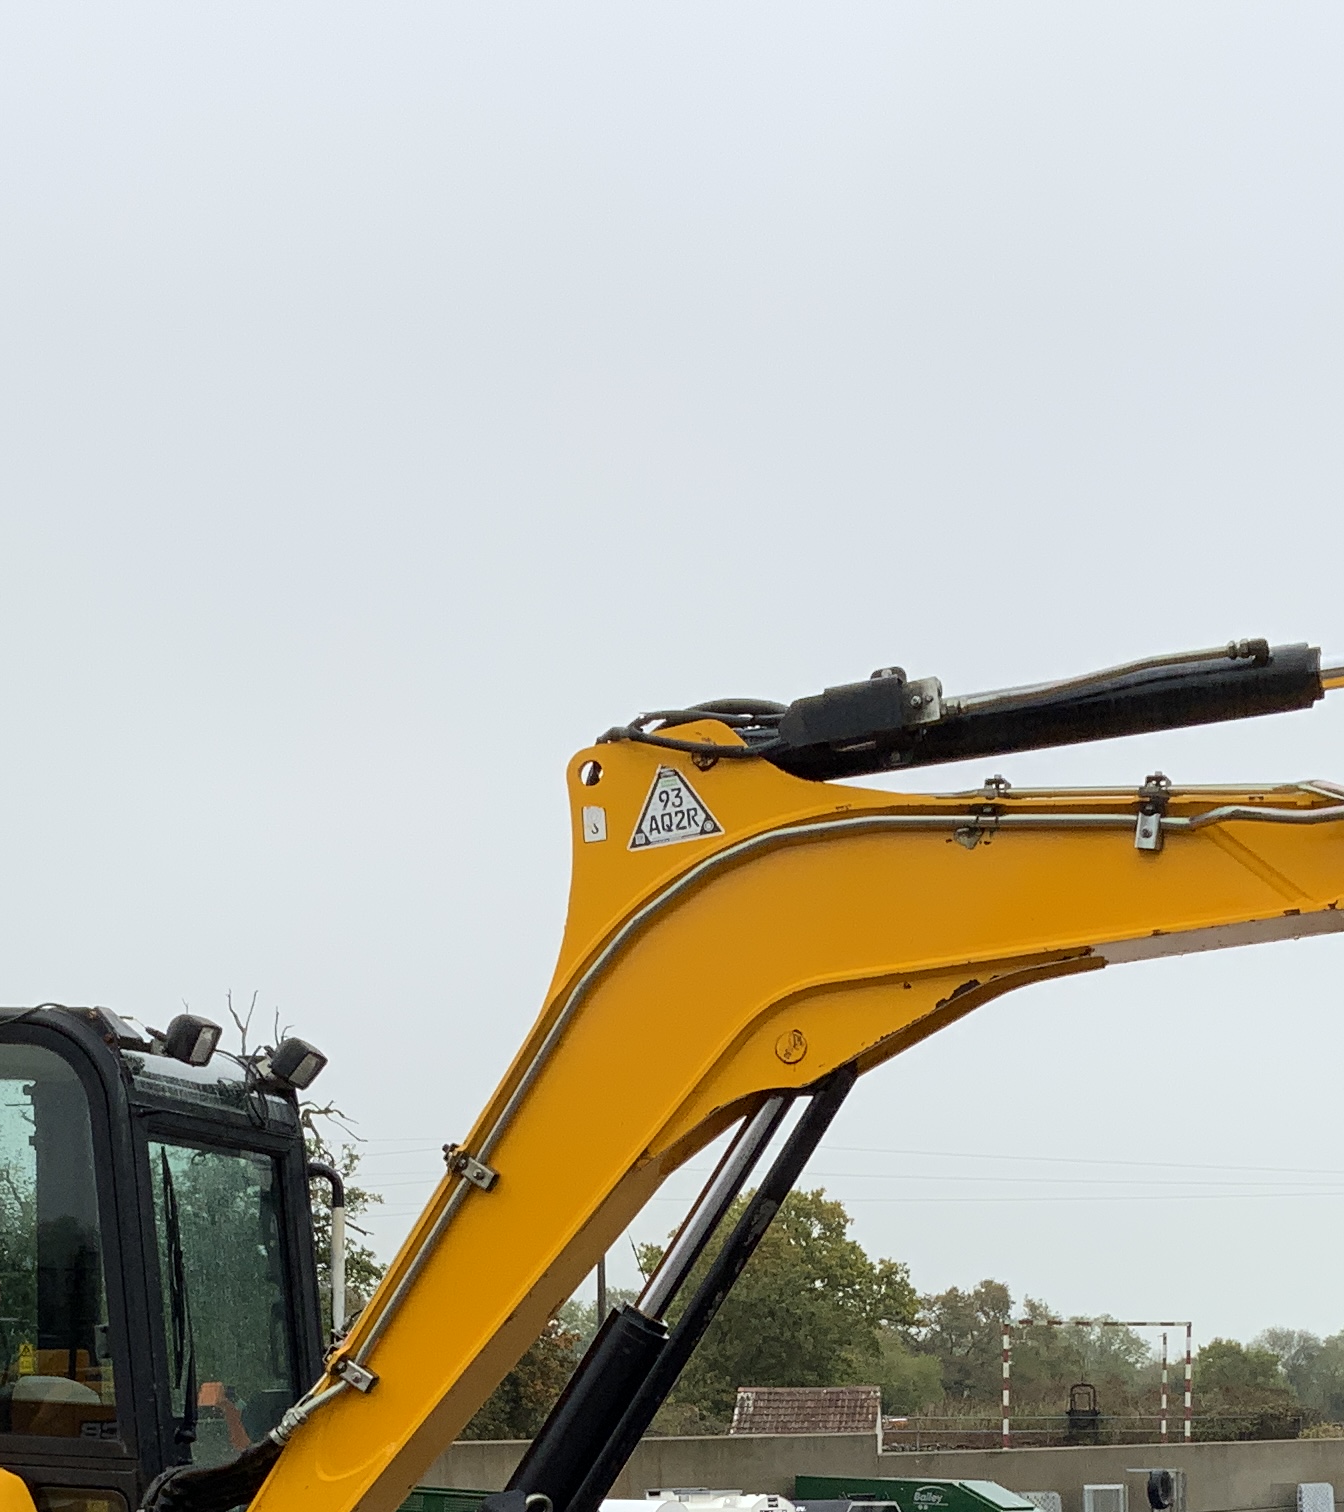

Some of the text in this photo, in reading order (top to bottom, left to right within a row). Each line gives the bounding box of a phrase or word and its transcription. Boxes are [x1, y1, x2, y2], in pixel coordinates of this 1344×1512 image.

[658, 787, 684, 810] 93
[649, 807, 700, 836] AQ2R
[913, 1491, 944, 1505] Bailey
